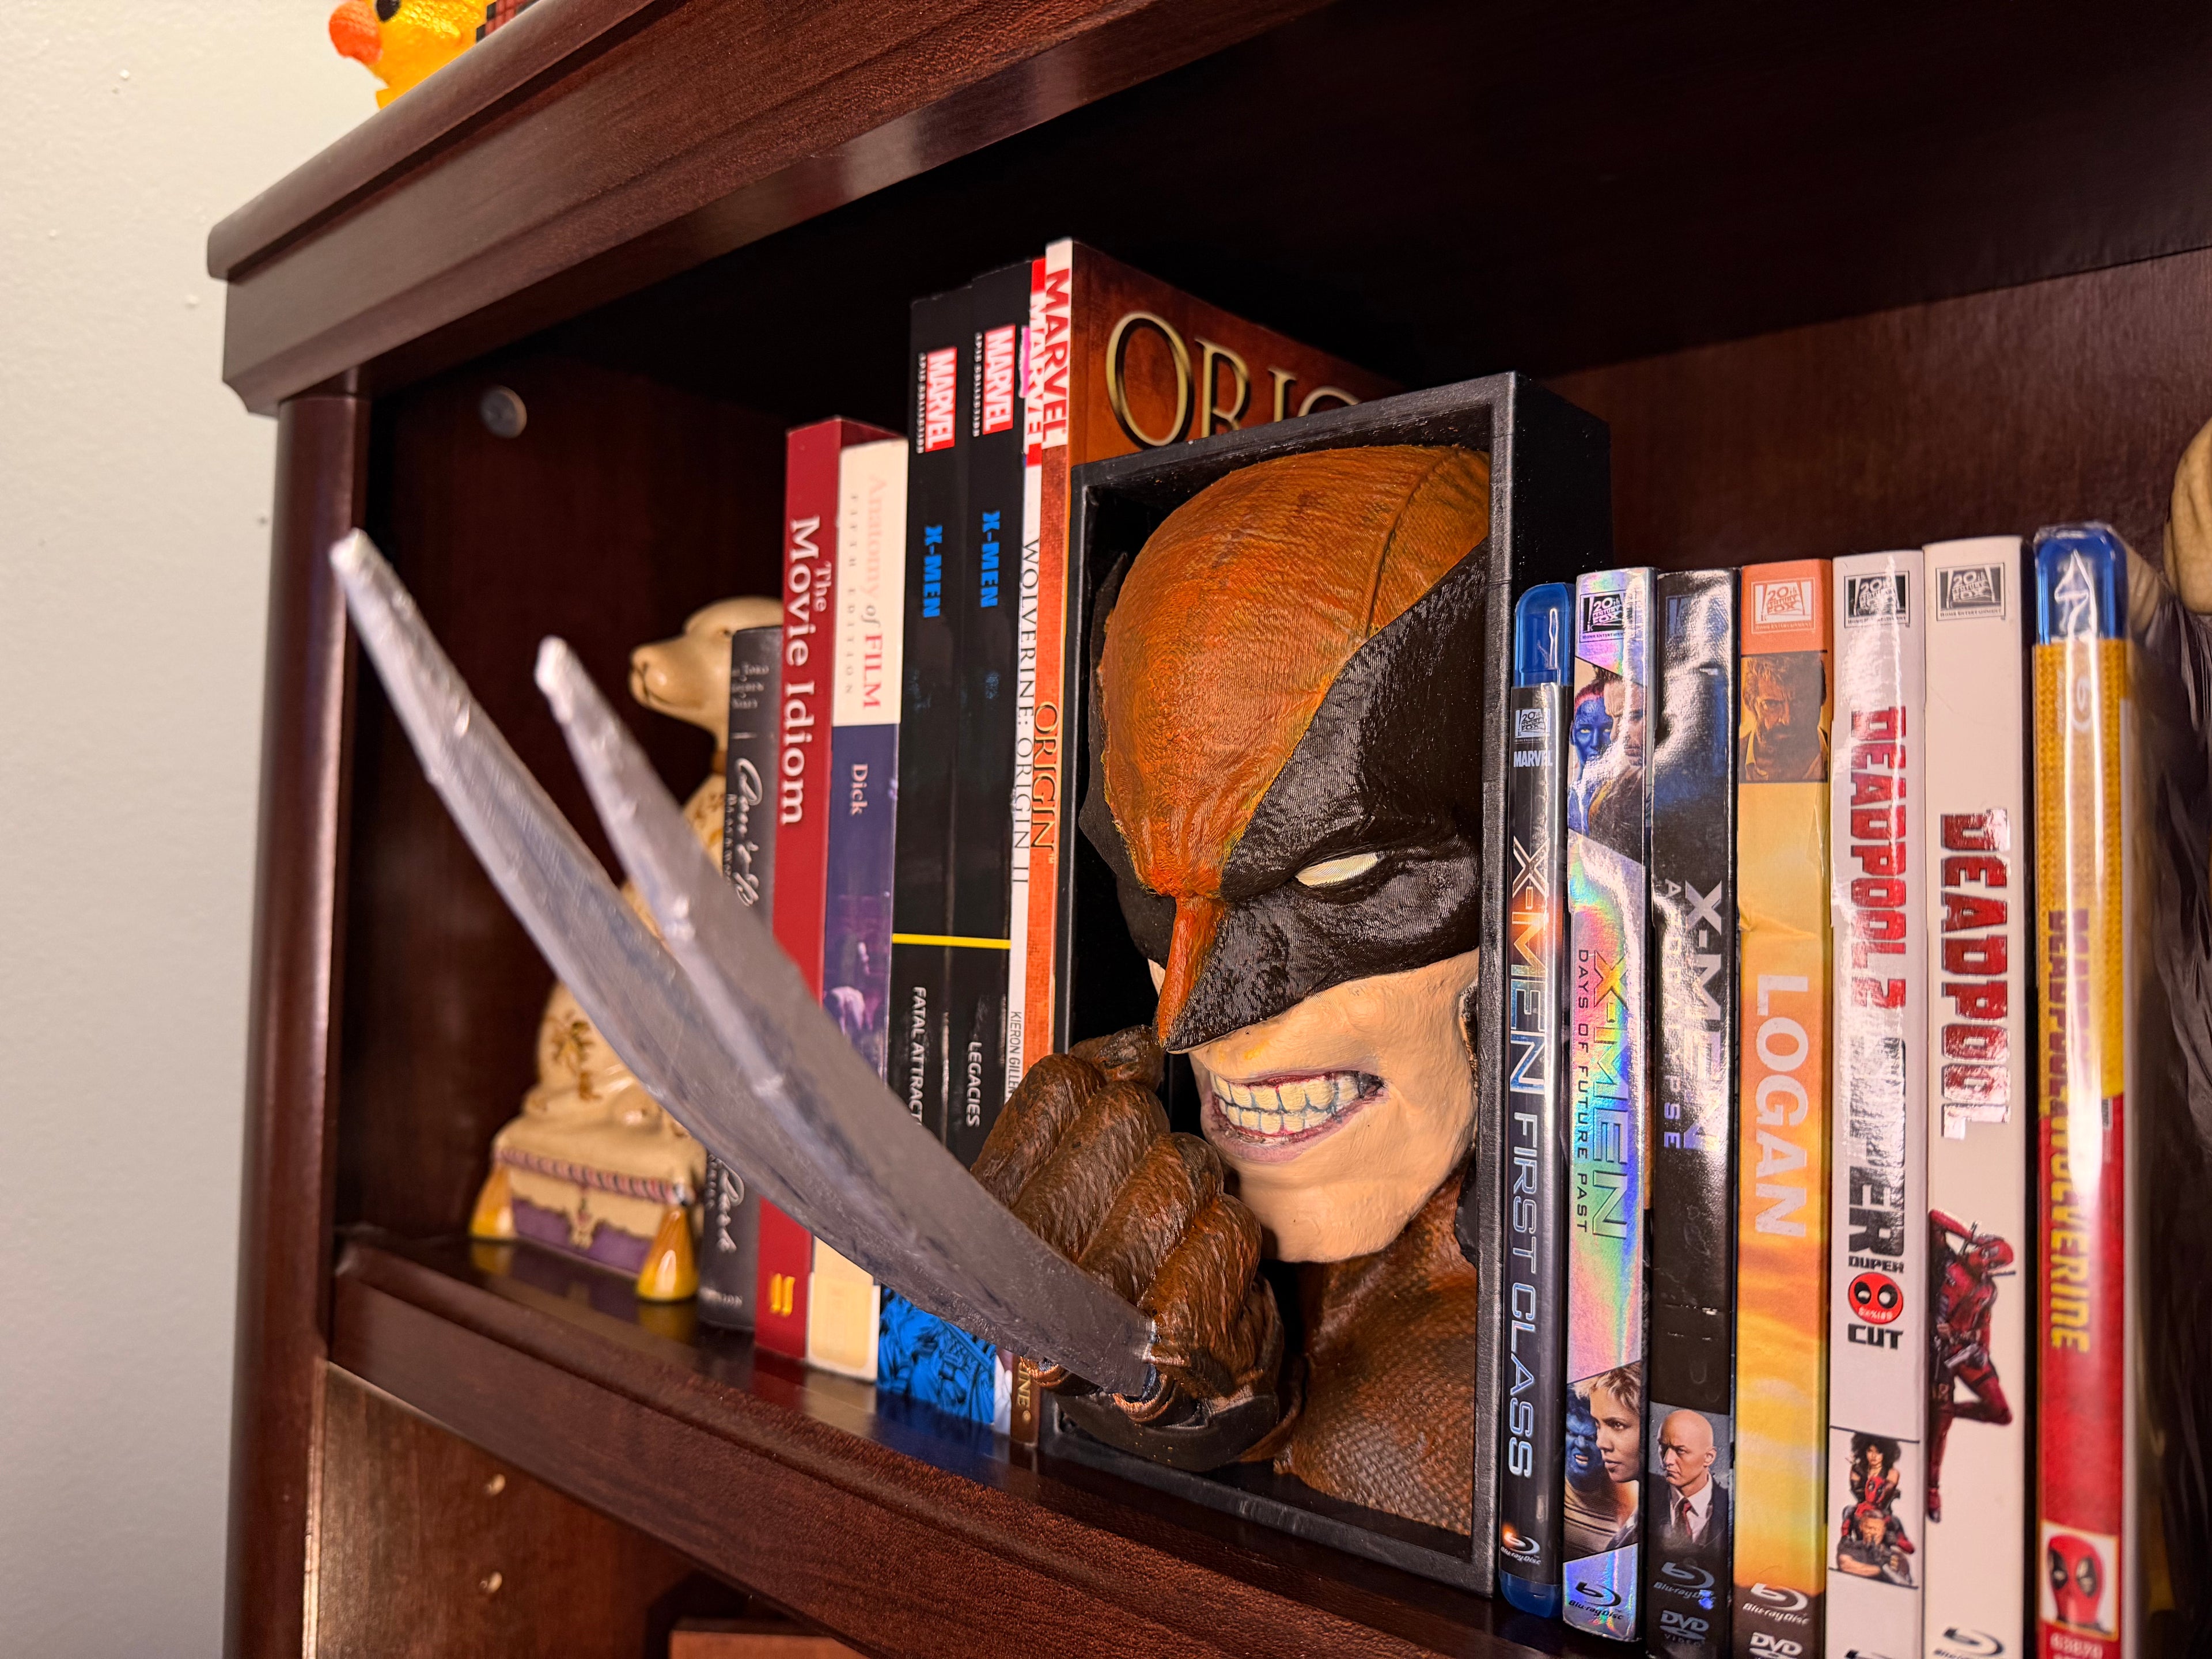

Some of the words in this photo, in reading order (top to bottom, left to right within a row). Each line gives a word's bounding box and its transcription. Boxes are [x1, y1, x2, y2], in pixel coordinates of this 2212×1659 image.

[926, 348, 955, 449] MARVEL
[984, 325, 1014, 434] MARVEL
[1027, 294, 1045, 446] MARVEL
[1043, 268, 1069, 443] MARVEL
[861, 475, 888, 601] Anatomy
[923, 525, 942, 618] X-MEN
[980, 510, 1000, 607] X-MEN
[786, 516, 820, 666] Movie
[813, 560, 832, 612] The
[861, 603, 881, 631] of
[1593, 597, 1620, 612] 20th
[1593, 612, 1618, 624] FOX
[1767, 601, 1795, 615] FOX
[1952, 588, 1984, 603] FOX
[845, 588, 856, 695] EDITION
[863, 634, 882, 709] FILM
[1017, 539, 1040, 725] WOLVERINE:
[779, 681, 815, 825] Idiom
[850, 764, 868, 815] Dick
[1014, 737, 1033, 849] ORIGIN
[1031, 701, 1059, 851] ORIGIN
[1514, 750, 1553, 767] MARVEL
[1012, 867, 1028, 882] II
[1850, 706, 1906, 969] DEADPOOL
[1510, 835, 1551, 1092] X-MEN
[1578, 949, 1589, 1008] DAYS
[1850, 978, 1906, 1008] 2
[1939, 809, 2010, 1140] DEADPOOL
[911, 986, 927, 1037] FATAL
[1009, 1012, 1022, 1054] KIERON
[1578, 1024, 1588, 1053] OF
[1684, 880, 1722, 1152] X-MEN
[908, 1041, 925, 1126] ATTRACT
[966, 1041, 982, 1127] LEGACIES
[1009, 1057, 1020, 1094] GILLEN
[1577, 1066, 1589, 1160] FUTURE
[1592, 950, 1629, 1240] X-MEN
[1755, 974, 1809, 1237] LOGAN
[1849, 1036, 1906, 1257] PER
[1513, 1112, 1537, 1274] FIRST
[1576, 1172, 1588, 1233] PAST
[1848, 1255, 1904, 1274] DUPER
[1508, 1282, 1536, 1479] CLASS
[1848, 1323, 1903, 1350] CUT
[1661, 1610, 1709, 1632] DVD
[1751, 1631, 1803, 1656] DVD
